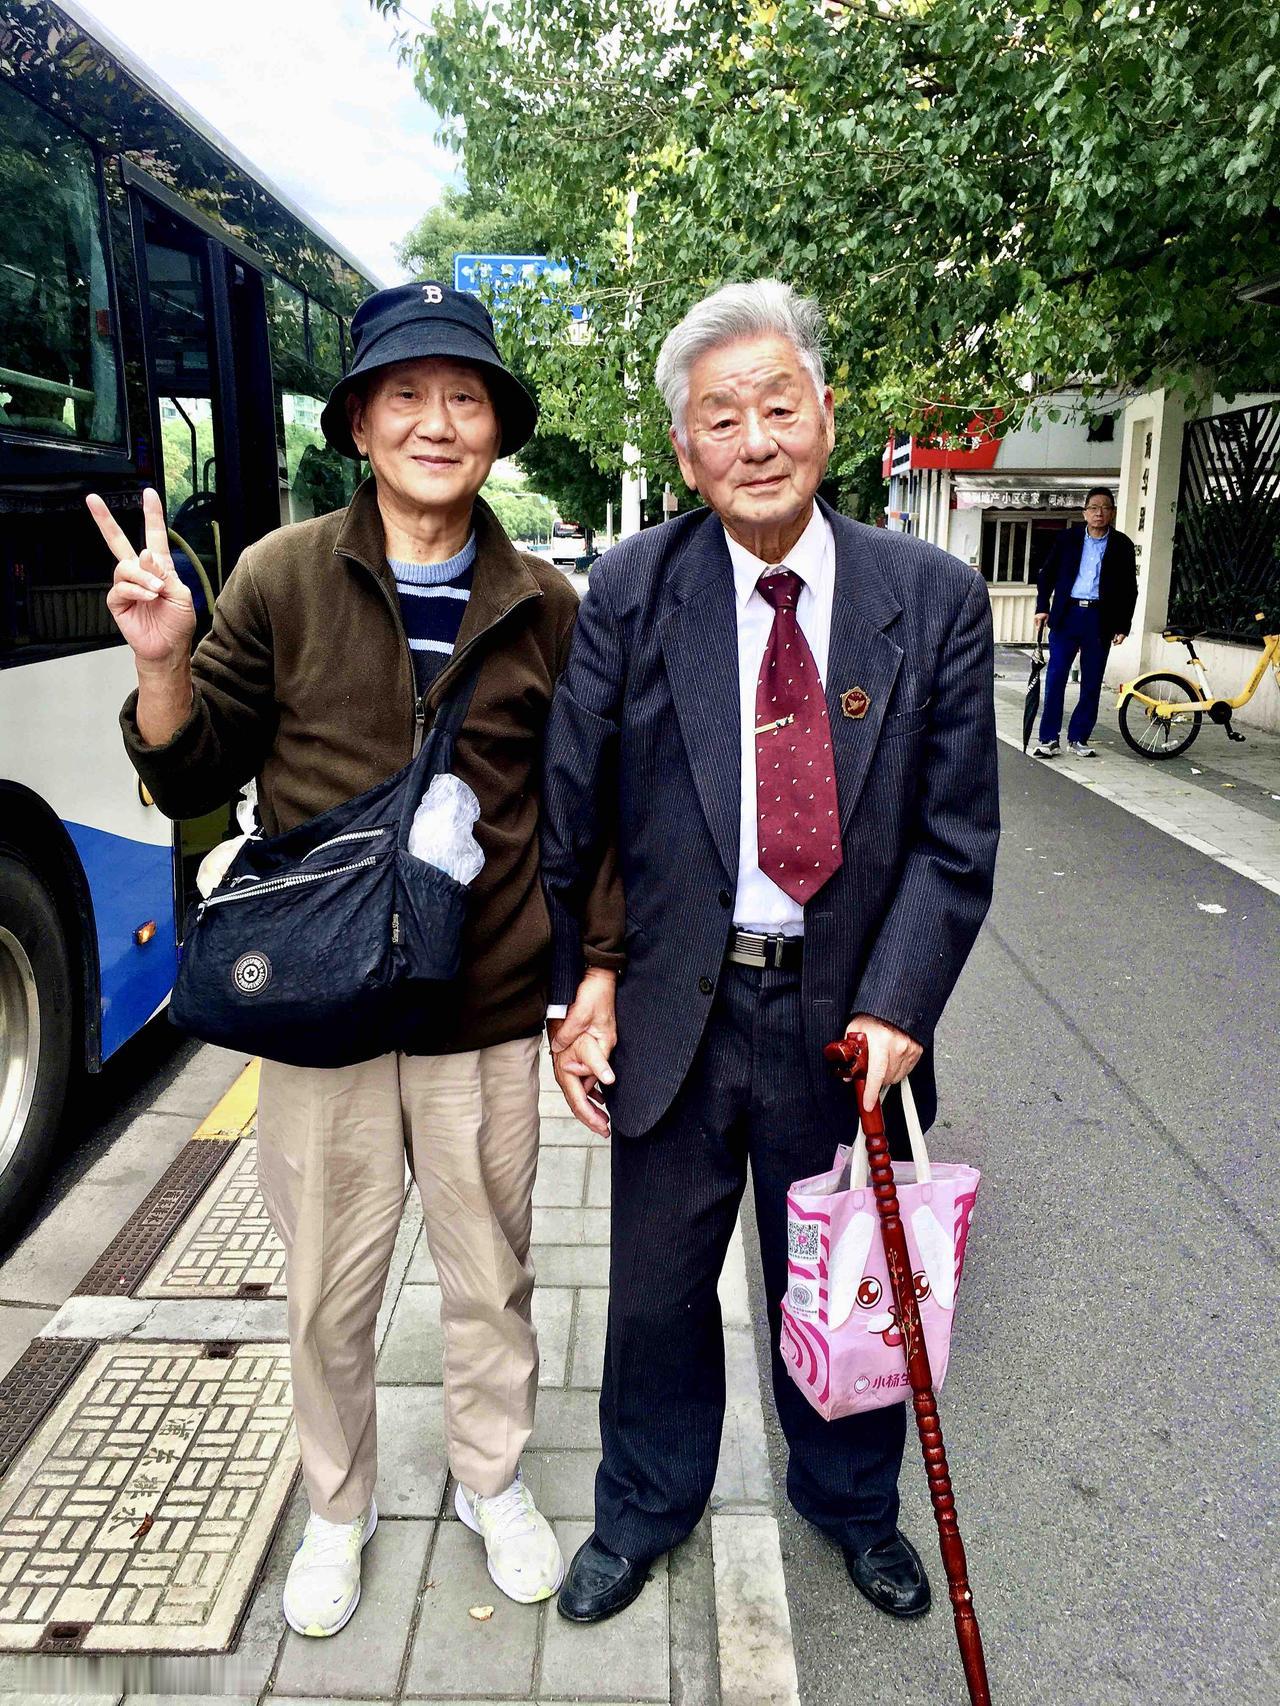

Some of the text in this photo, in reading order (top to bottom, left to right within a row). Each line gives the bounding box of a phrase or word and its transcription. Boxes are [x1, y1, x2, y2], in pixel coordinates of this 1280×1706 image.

[422, 285, 443, 304] B
[108, 1411, 203, 1534] 浦东排水
